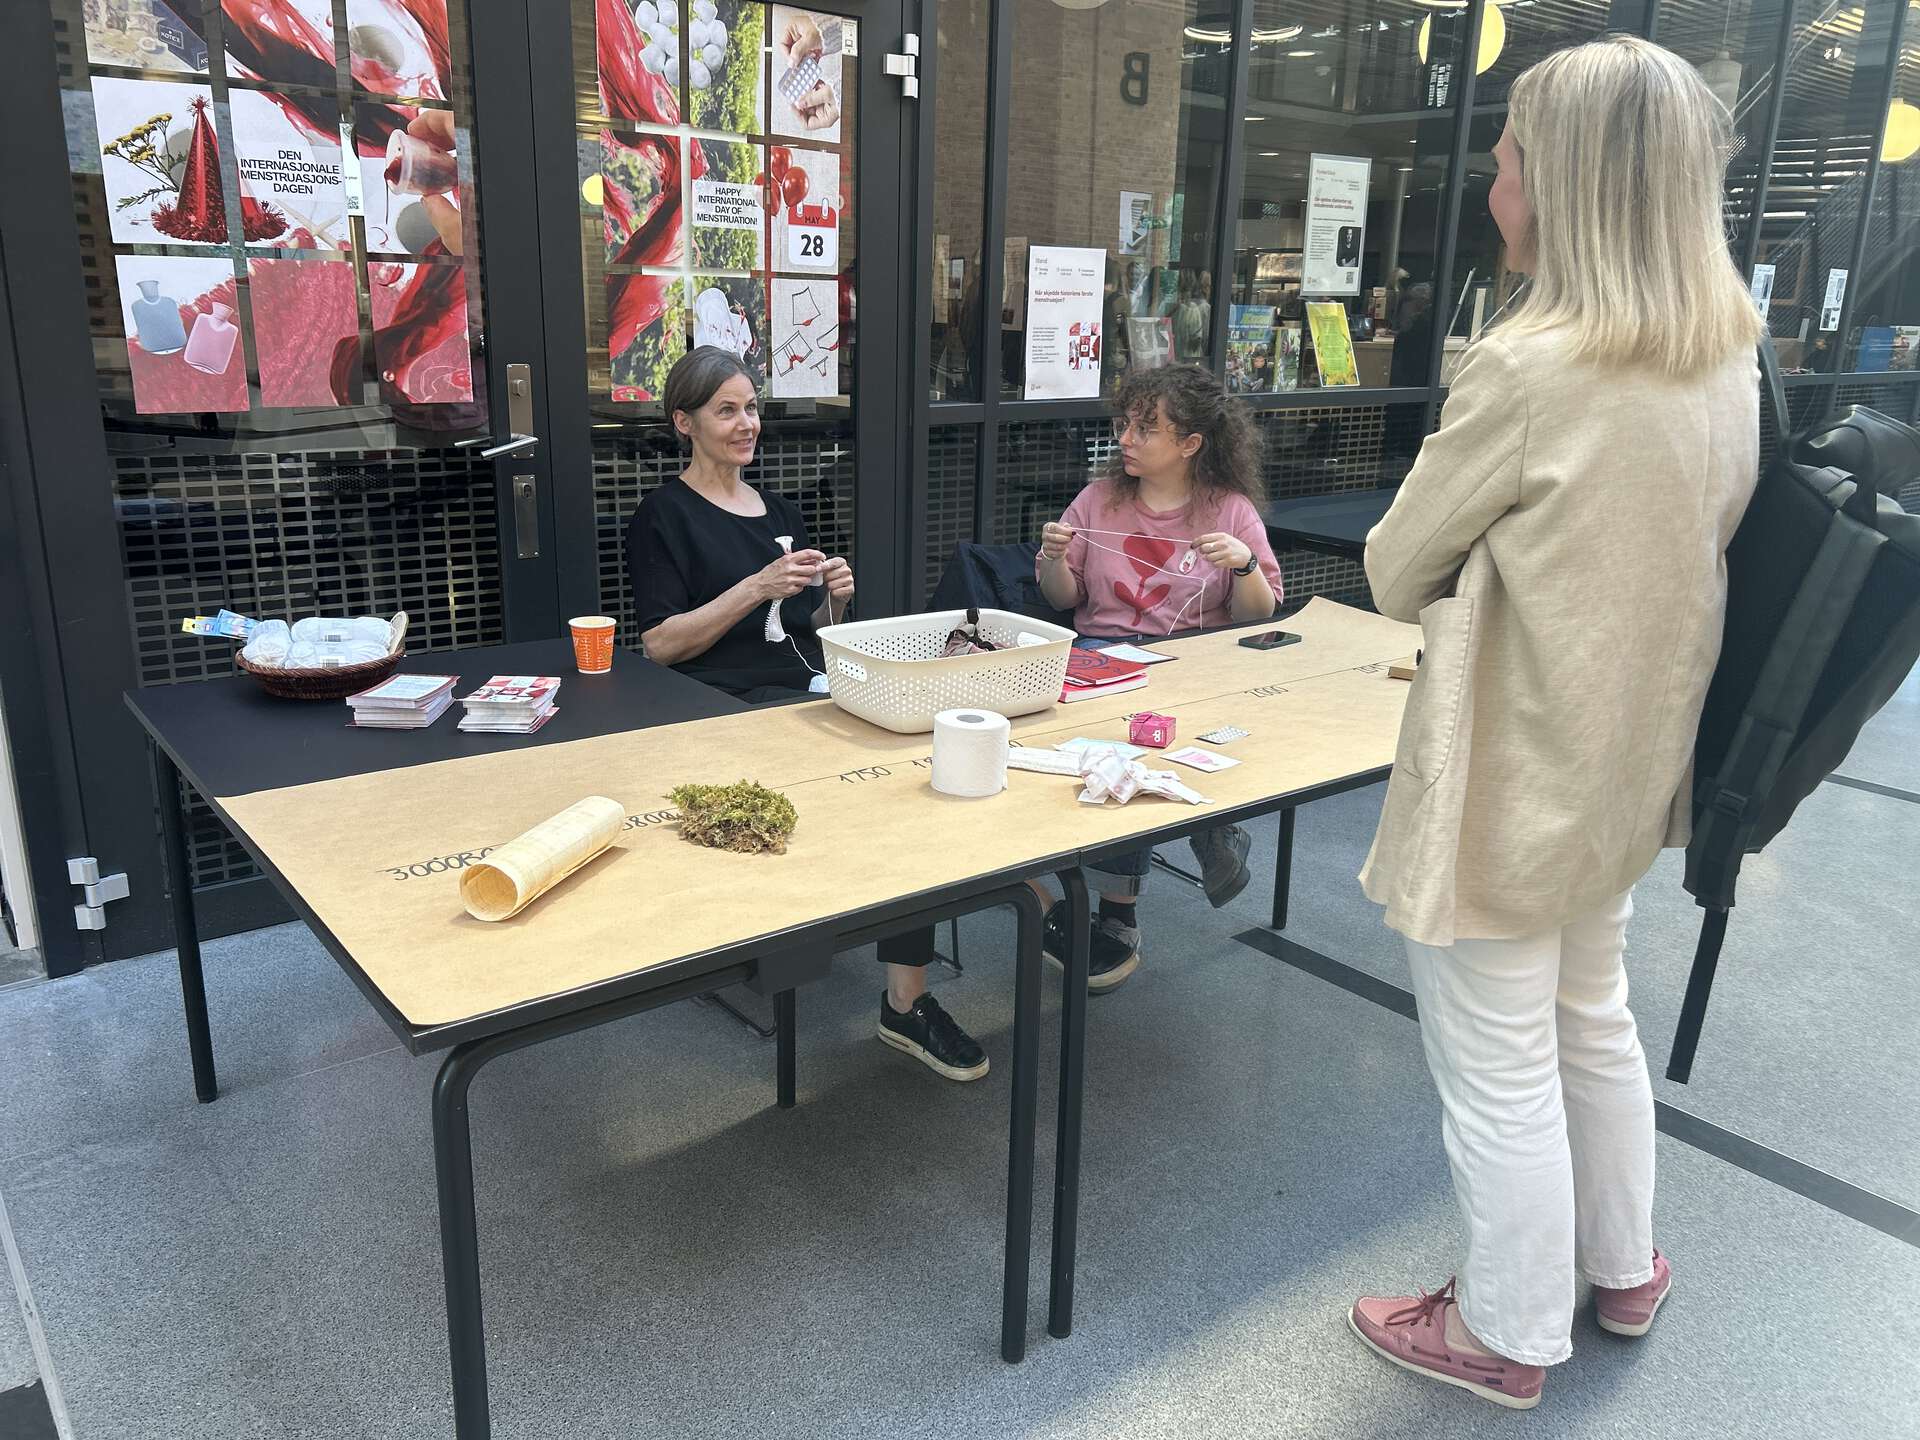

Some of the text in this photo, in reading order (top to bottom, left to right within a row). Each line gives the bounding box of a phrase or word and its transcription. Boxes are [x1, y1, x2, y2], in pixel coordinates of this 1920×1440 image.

[278, 150, 302, 160] DEN
[240, 158, 340, 175] INTERNASJONALE
[240, 169, 342, 186] MENSTRUASJONS-
[273, 183, 313, 194] DAGEN
[715, 187, 741, 197] HAPPY
[698, 195, 758, 208] INTERNATIONAL
[714, 206, 743, 215] DAY OF
[696, 213, 758, 225] MENSTRUATION!
[804, 216, 821, 225] MAY
[800, 233, 824, 257] 28
[839, 765, 892, 784] 1750
